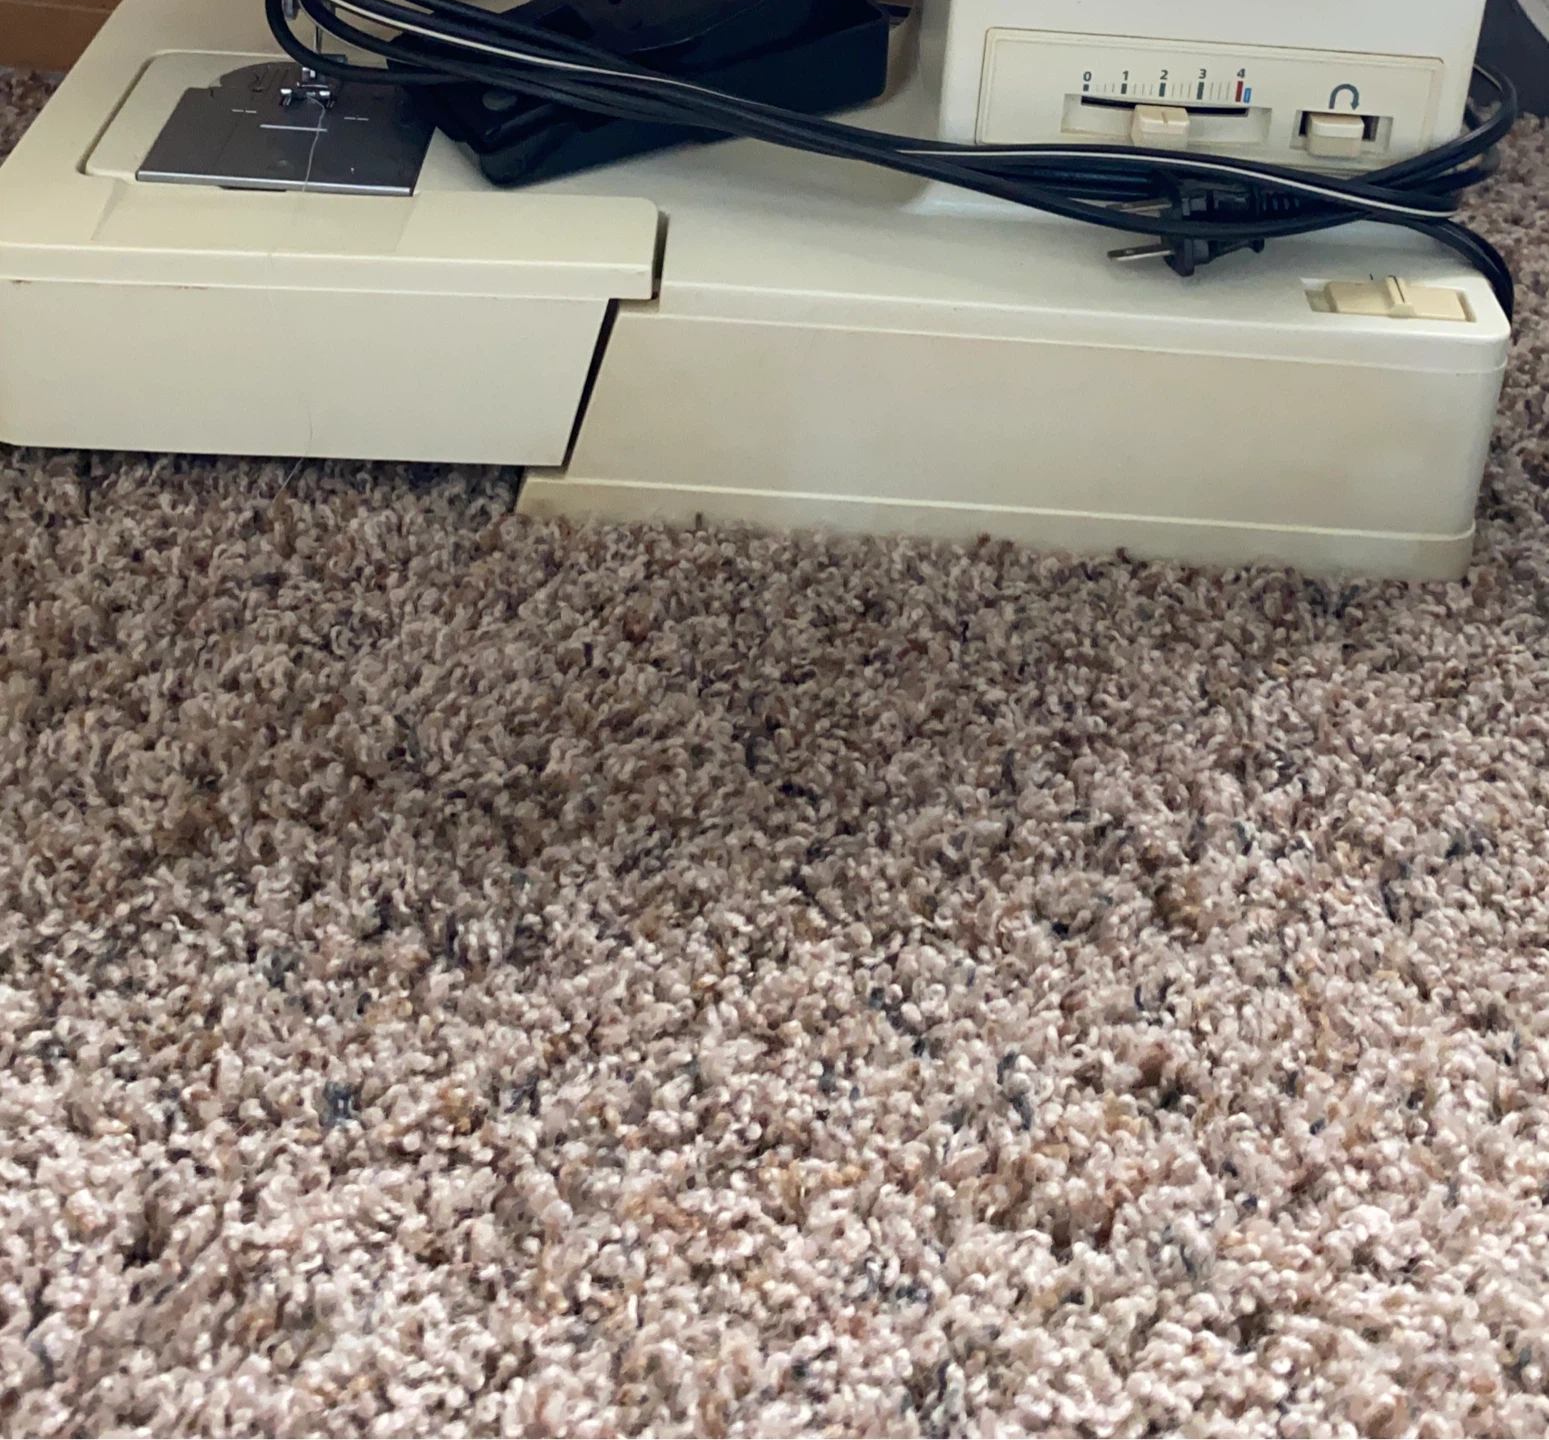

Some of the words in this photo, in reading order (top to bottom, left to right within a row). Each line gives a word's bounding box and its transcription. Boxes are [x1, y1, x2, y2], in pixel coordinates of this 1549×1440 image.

[1083, 71, 1092, 82] 0
[1122, 70, 1129, 81] 1
[1160, 69, 1169, 80] 2
[1199, 68, 1207, 79] 3
[1237, 68, 1246, 78] 4
